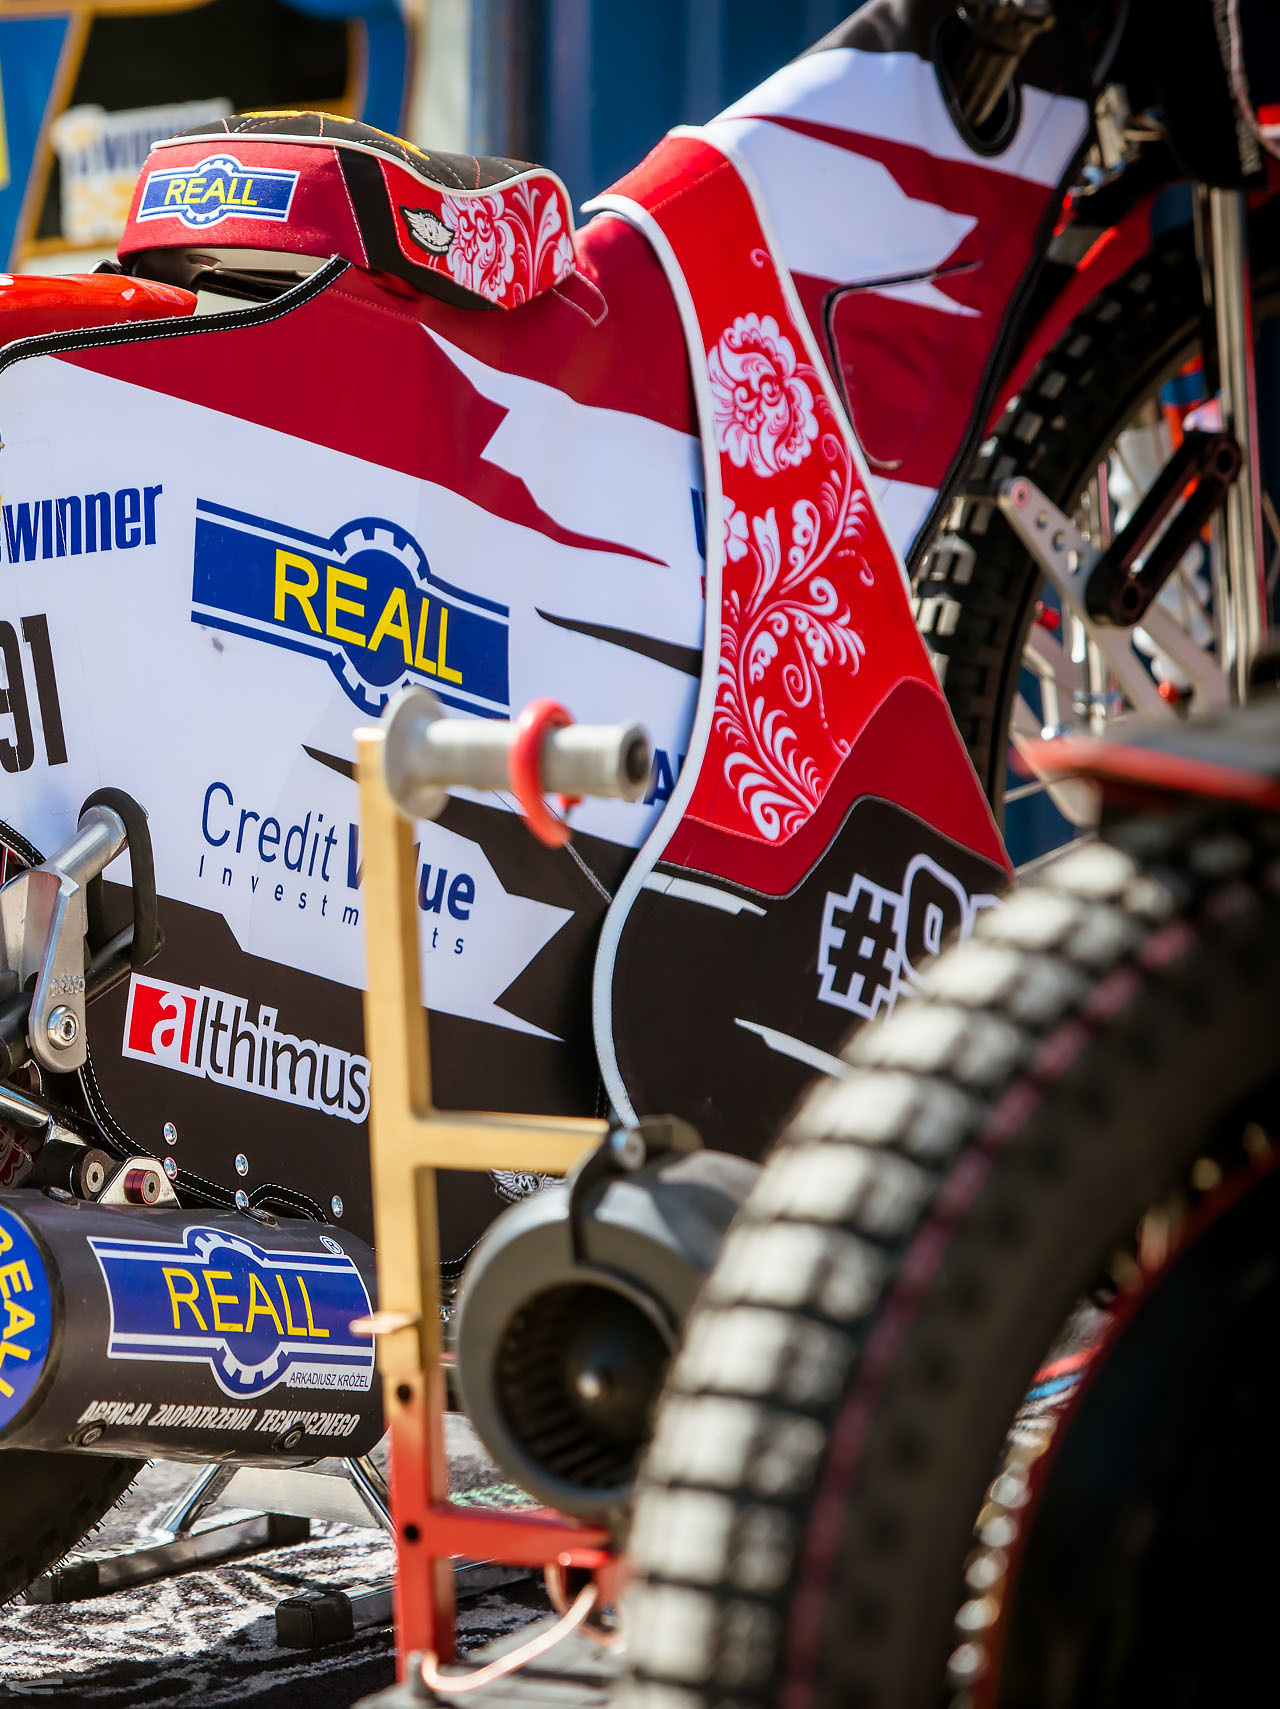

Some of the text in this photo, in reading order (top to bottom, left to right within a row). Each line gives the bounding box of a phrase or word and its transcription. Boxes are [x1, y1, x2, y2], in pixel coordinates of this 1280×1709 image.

[163, 176, 258, 206] REALL
[273, 547, 463, 685] REALL
[201, 781, 476, 921] Credit Vue
[198, 855, 465, 955] Investmts
[817, 853, 1005, 1021] #9
[150, 991, 368, 1112] althimus
[161, 1266, 330, 1338] REALL
[147, 1403, 258, 1431] ZAOPATRZENIA
[288, 1371, 369, 1388] ARKADIUSZ KRÓŻEL
